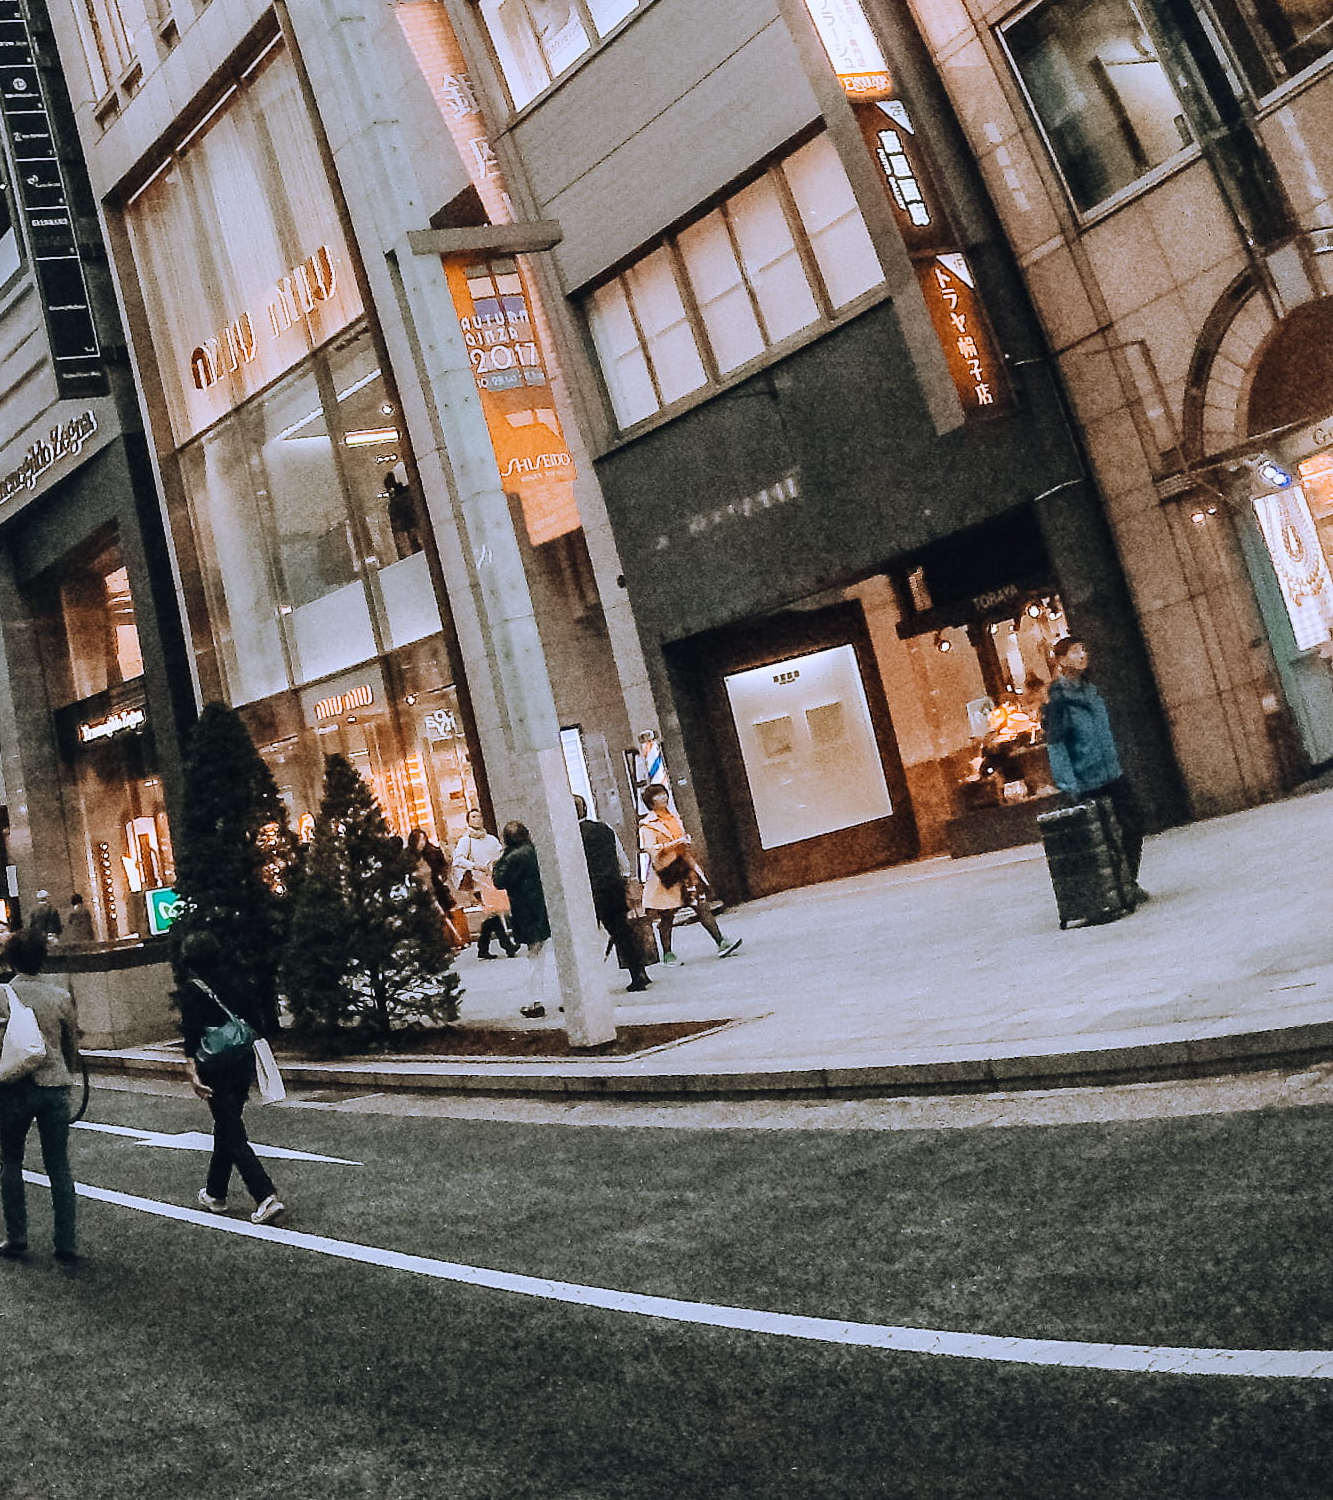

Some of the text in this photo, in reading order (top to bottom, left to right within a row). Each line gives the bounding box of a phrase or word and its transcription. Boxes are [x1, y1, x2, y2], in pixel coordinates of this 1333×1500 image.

[461, 307, 530, 334] AUTUMN
[465, 328, 520, 348] GINZA
[935, 268, 994, 405] トラヤ帽子店
[470, 342, 538, 371] 2017
[500, 451, 571, 477] SHISEIDO
